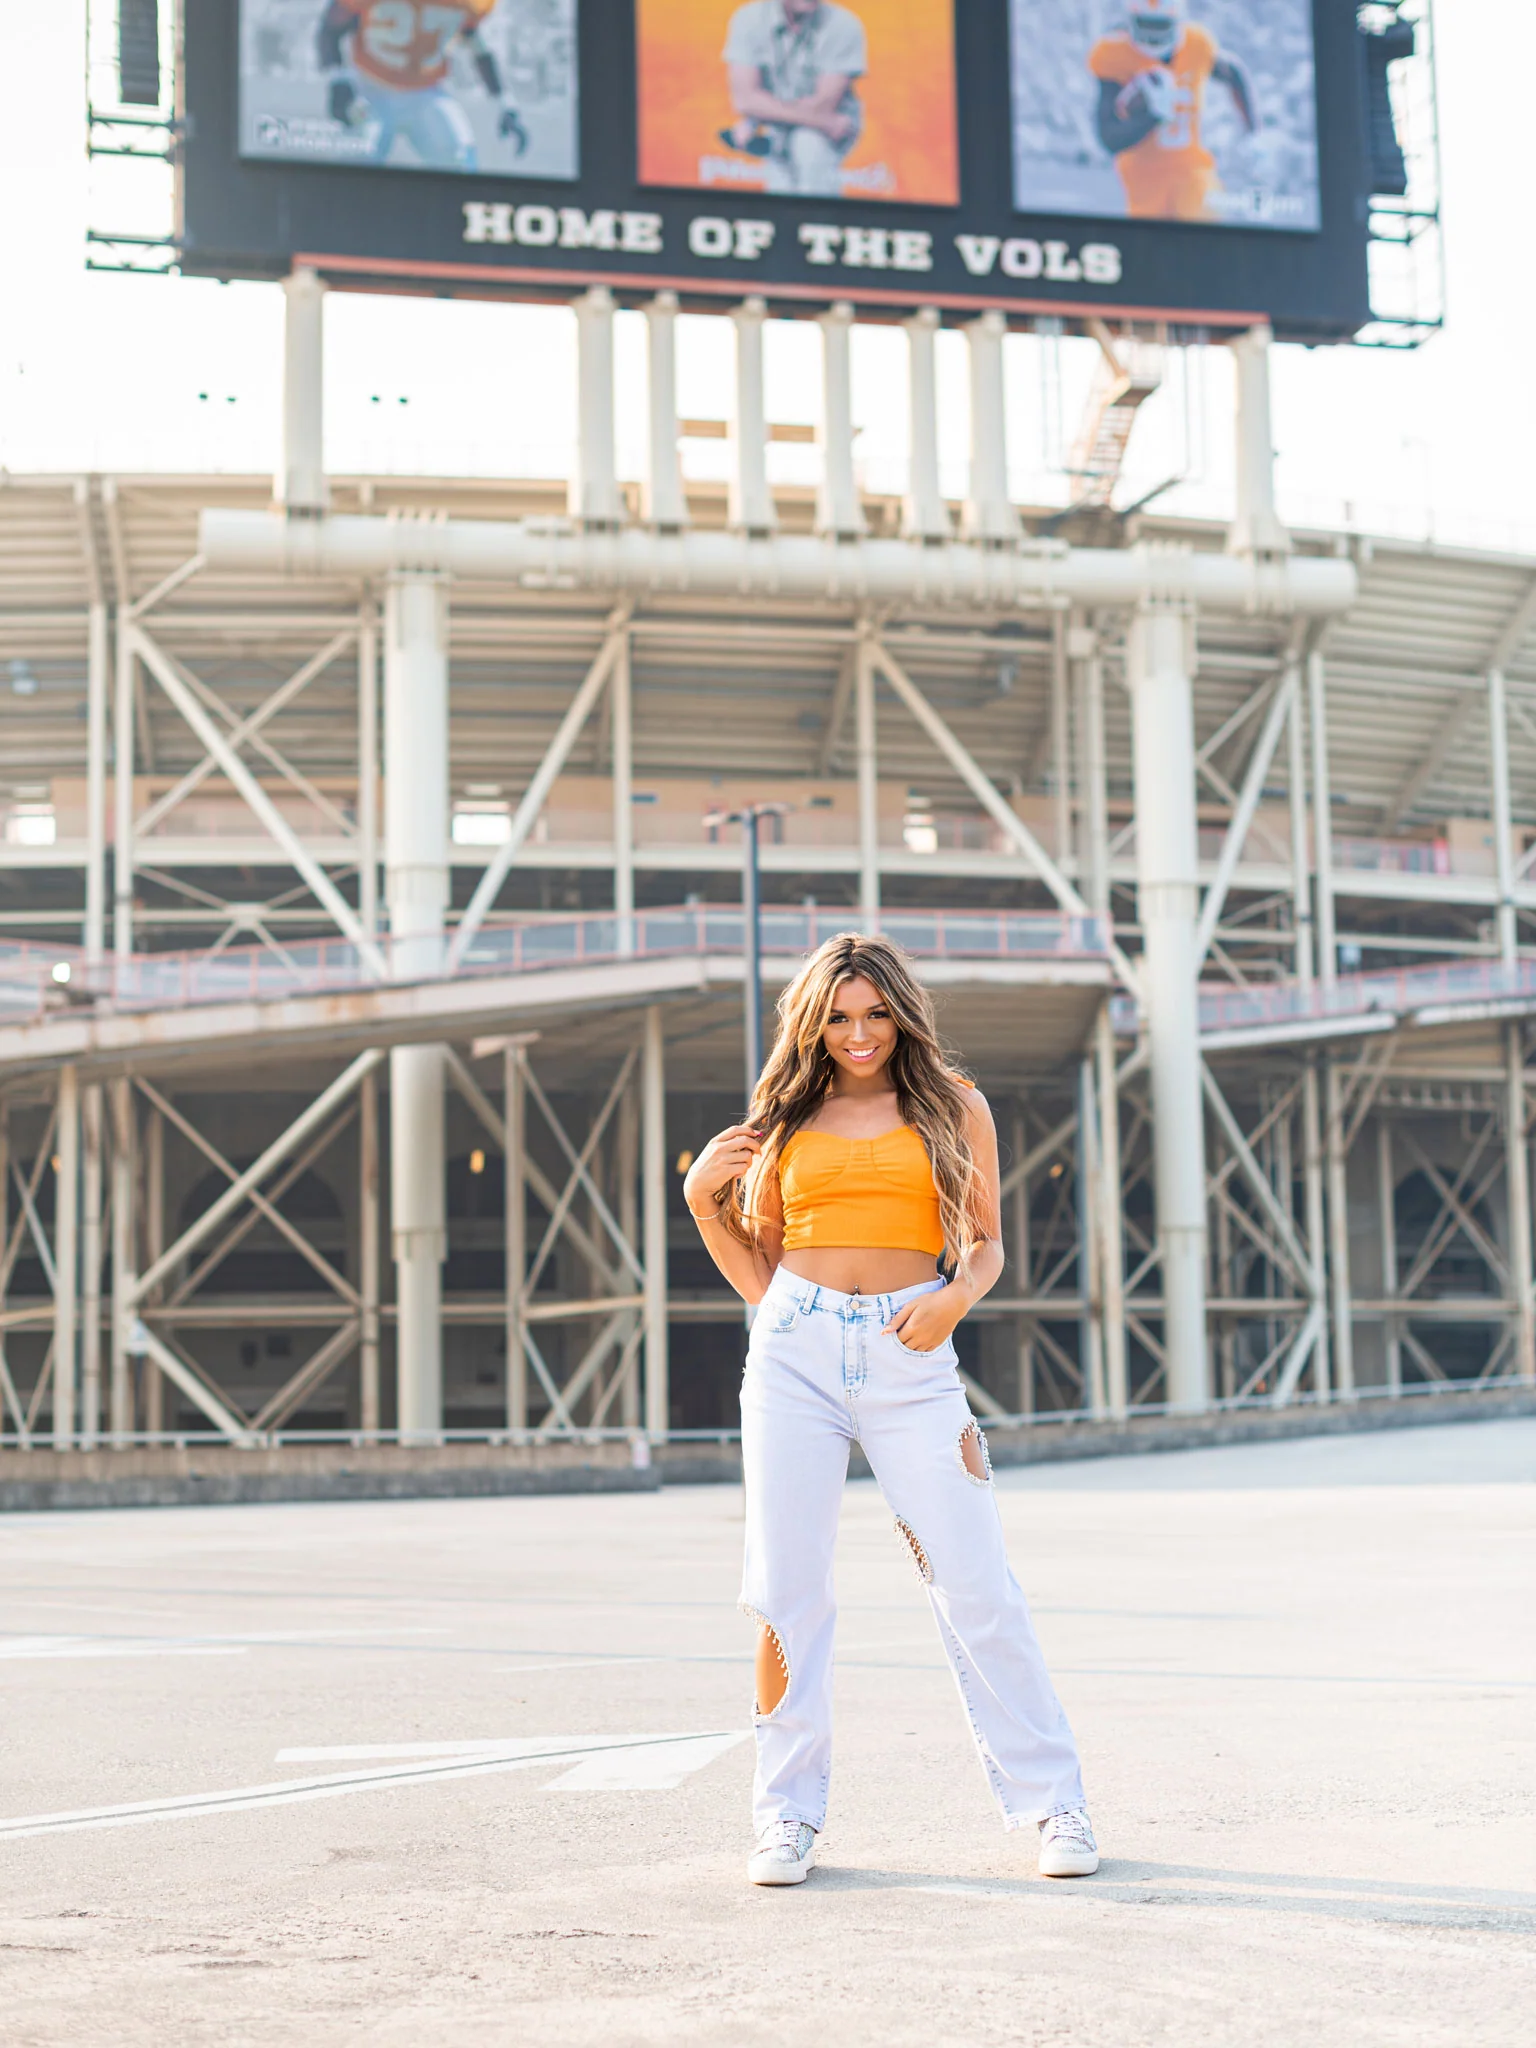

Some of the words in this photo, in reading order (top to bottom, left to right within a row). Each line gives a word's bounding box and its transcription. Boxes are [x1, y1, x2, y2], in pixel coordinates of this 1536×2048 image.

[361, 2, 467, 70] 27
[463, 202, 663, 253] HOME
[689, 216, 775, 260] OF
[798, 223, 934, 272] THE
[954, 234, 1122, 284] VOLS
